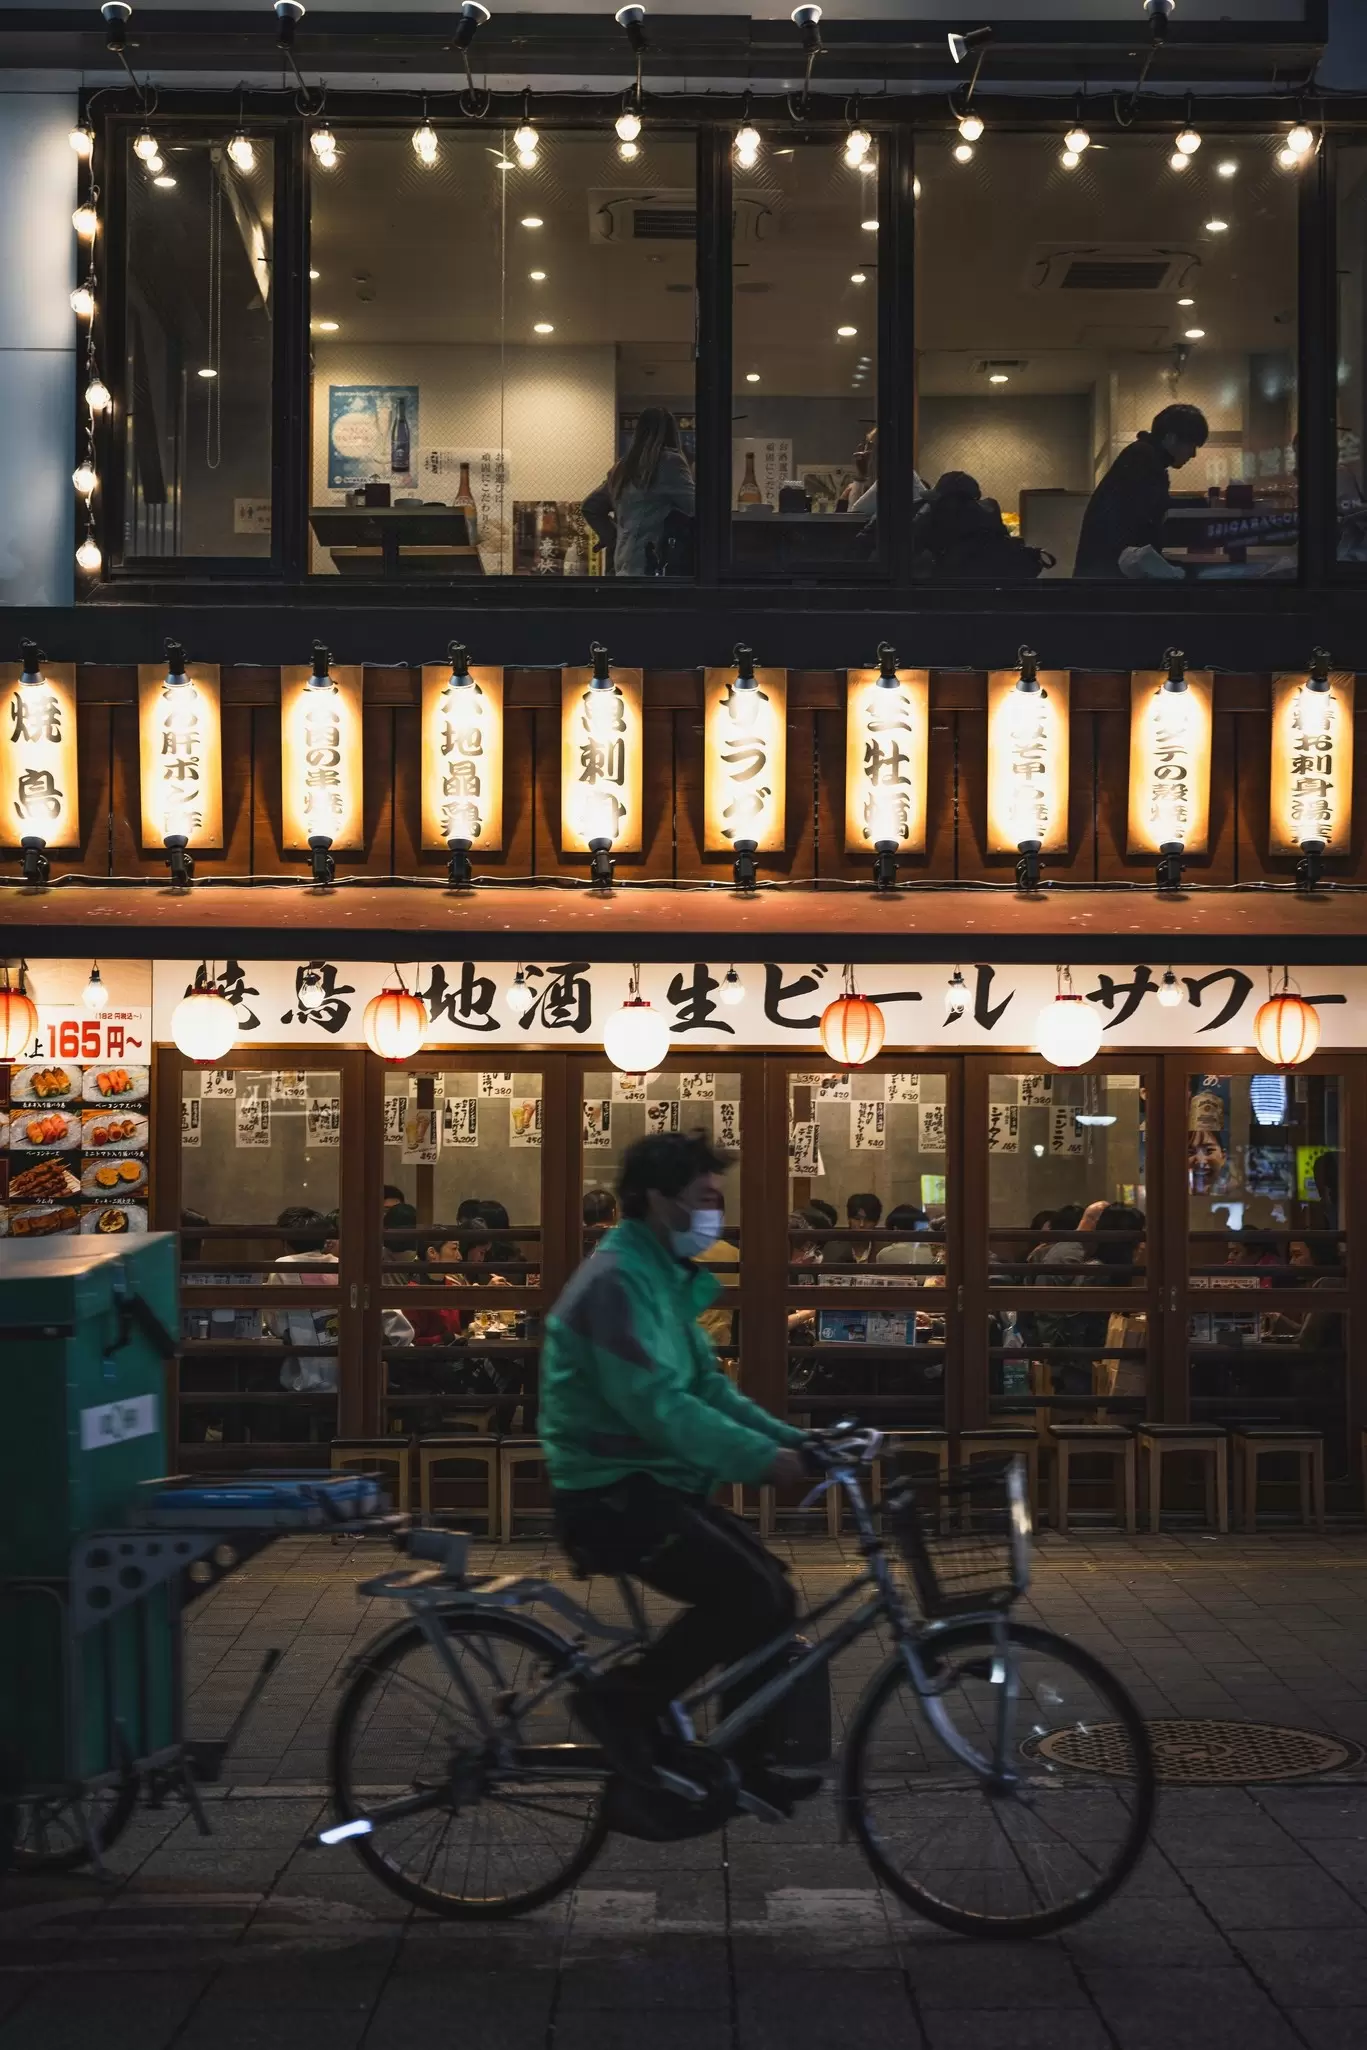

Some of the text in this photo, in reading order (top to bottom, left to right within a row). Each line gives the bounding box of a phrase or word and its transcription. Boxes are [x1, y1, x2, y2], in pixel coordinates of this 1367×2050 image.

[10, 691, 63, 820] 焼鳥
[427, 961, 592, 1033] 地酒
[666, 962, 1015, 1034] 生ビール
[1086, 965, 1347, 1034] サワー
[802, 1075, 820, 1083] 350
[217, 1087, 234, 1095] 390
[494, 1087, 511, 1095] 380
[696, 1090, 713, 1098] 530
[901, 1093, 918, 1101] 530
[720, 1103, 734, 1140] 松竹梅
[1052, 1109, 1068, 1151] ニンニク
[453, 1136, 477, 1144] 3,200
